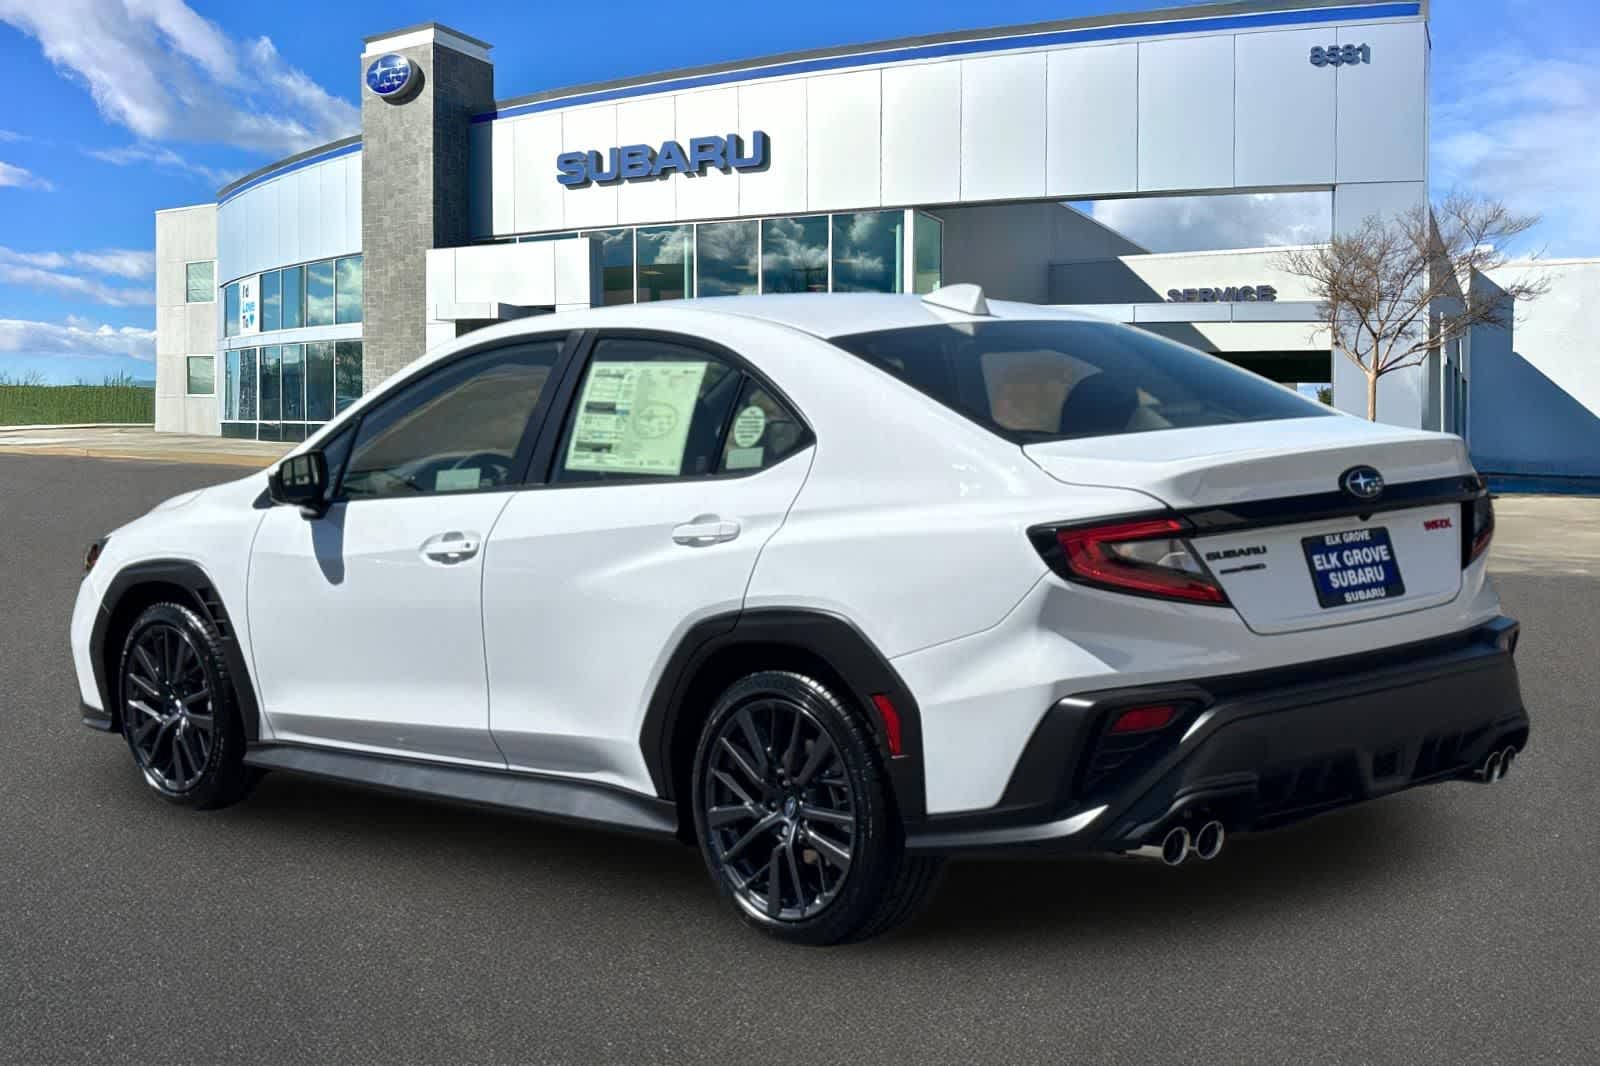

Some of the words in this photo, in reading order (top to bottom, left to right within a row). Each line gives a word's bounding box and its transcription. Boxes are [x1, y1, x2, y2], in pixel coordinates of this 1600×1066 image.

[556, 130, 771, 190] SUBARU
[1167, 285, 1277, 303] SERVICE
[1325, 534, 1341, 546] ELK
[1342, 530, 1370, 543] GROVE
[1206, 546, 1267, 561] SUBARU
[1312, 552, 1341, 571] ELK
[1342, 545, 1391, 567] GROVE
[1329, 564, 1385, 589] SUBARU
[1344, 587, 1386, 603] SUBARU
